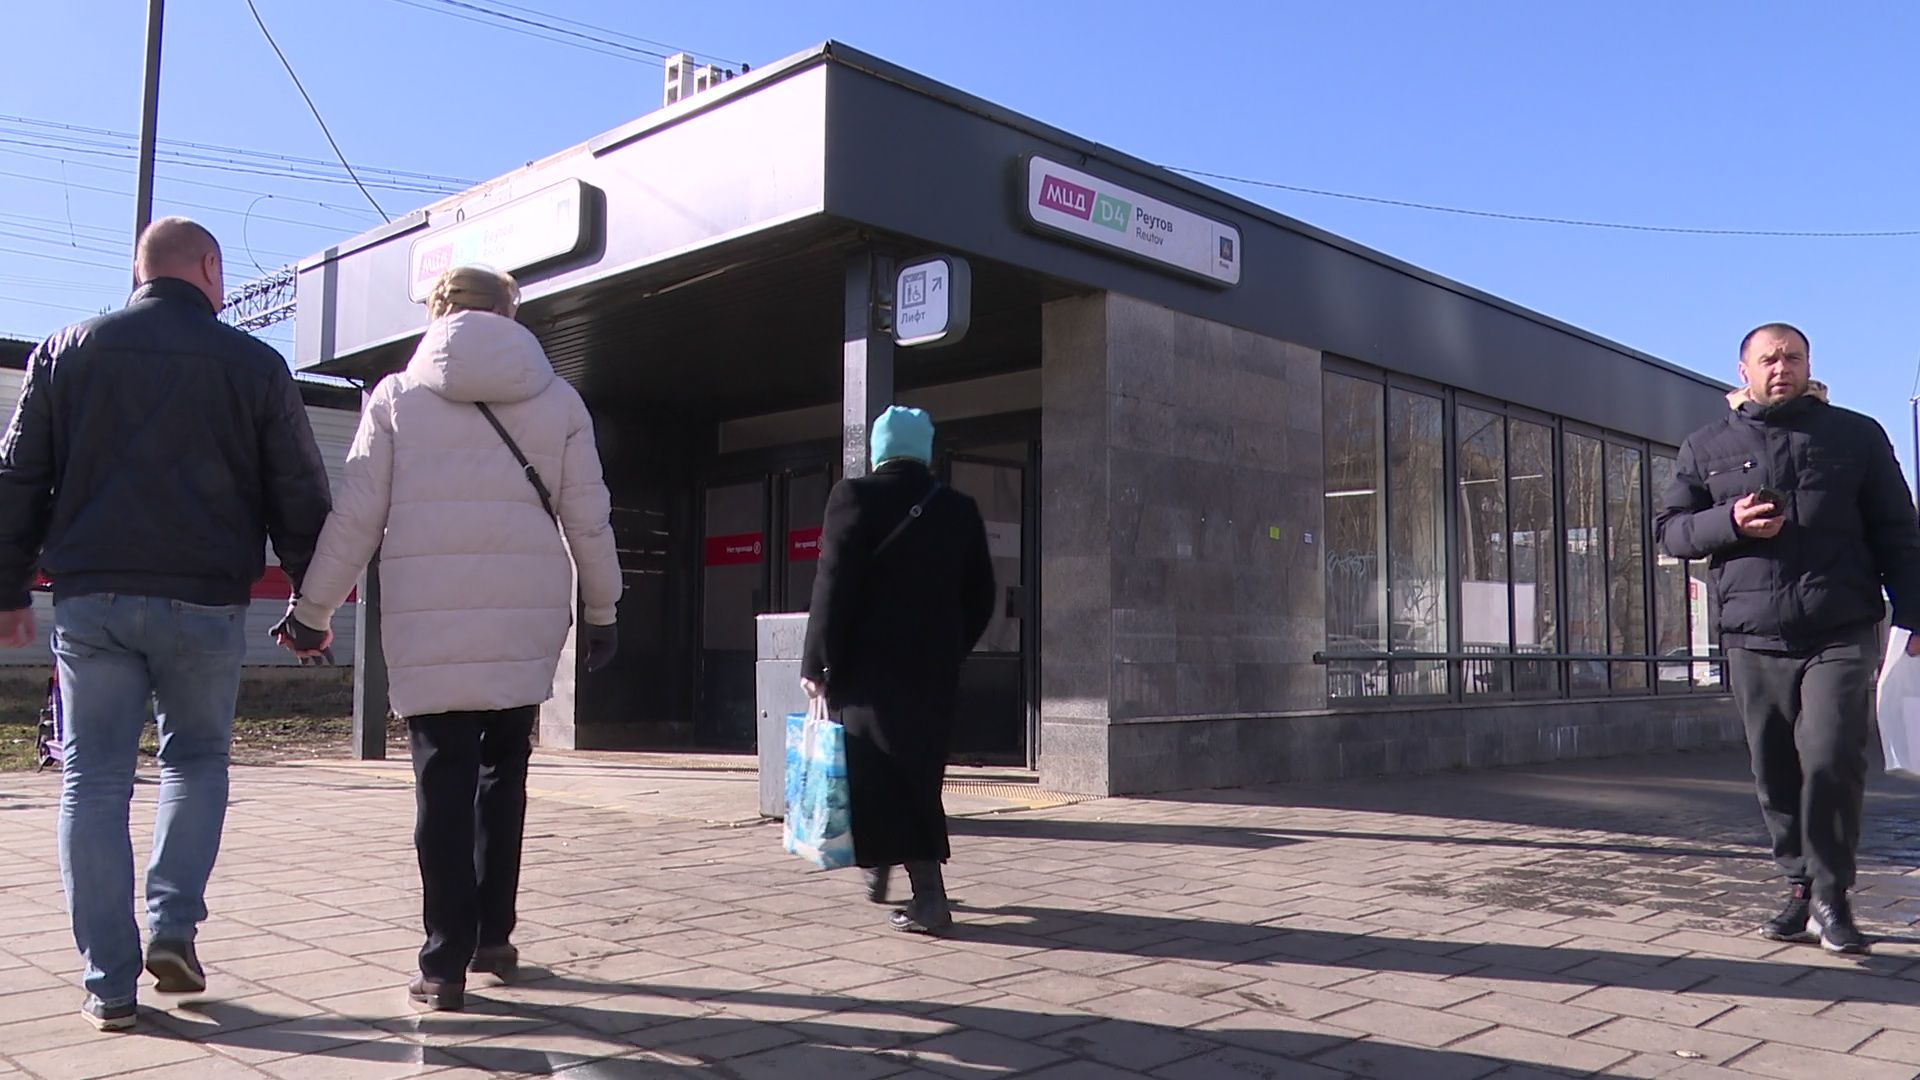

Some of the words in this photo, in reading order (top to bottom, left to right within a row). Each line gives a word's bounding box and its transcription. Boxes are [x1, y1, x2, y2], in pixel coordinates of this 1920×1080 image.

[1046, 183, 1087, 212] МЦД
[1099, 200, 1125, 227] D4
[1136, 207, 1173, 233] Реутов
[1136, 227, 1164, 246] Reutov
[901, 309, 926, 325] Лифт
